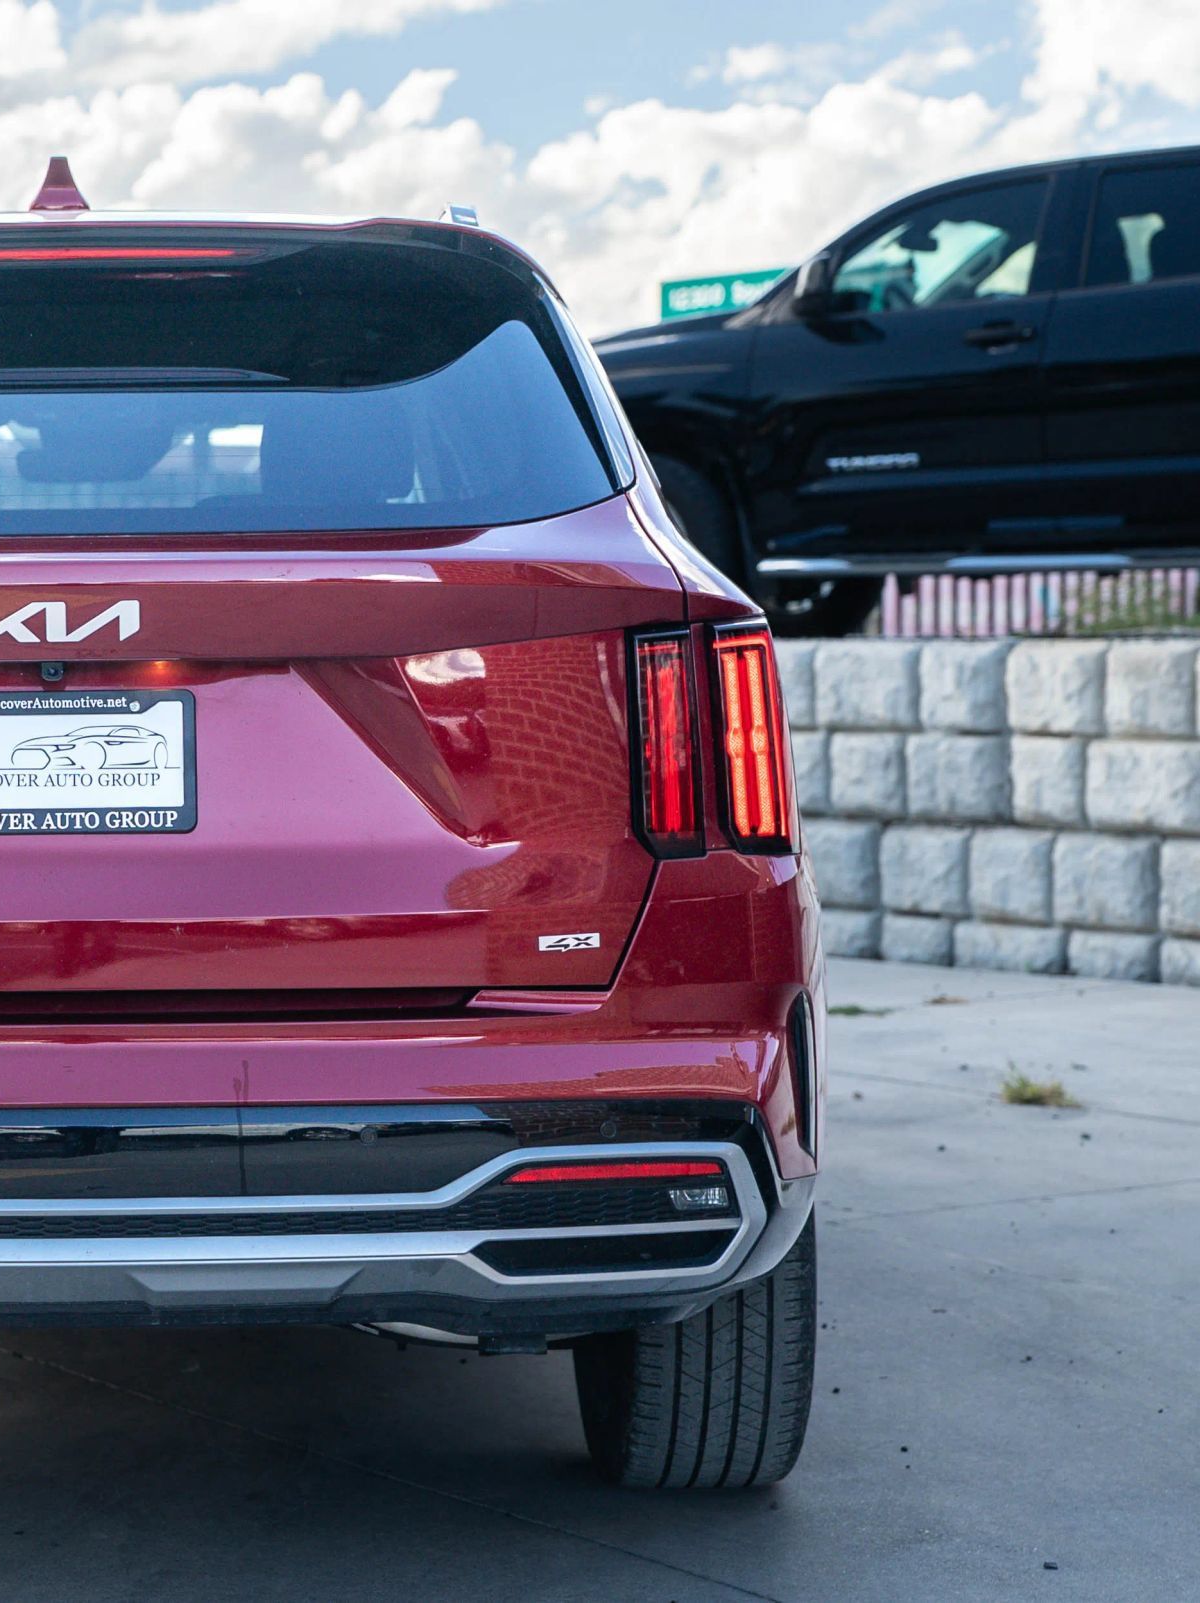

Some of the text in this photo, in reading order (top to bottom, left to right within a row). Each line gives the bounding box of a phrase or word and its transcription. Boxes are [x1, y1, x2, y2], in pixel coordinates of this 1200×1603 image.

[44, 773, 93, 787] AUTO
[98, 772, 161, 787] GROUP
[41, 812, 100, 830] AUTO
[105, 810, 178, 829] GROUP
